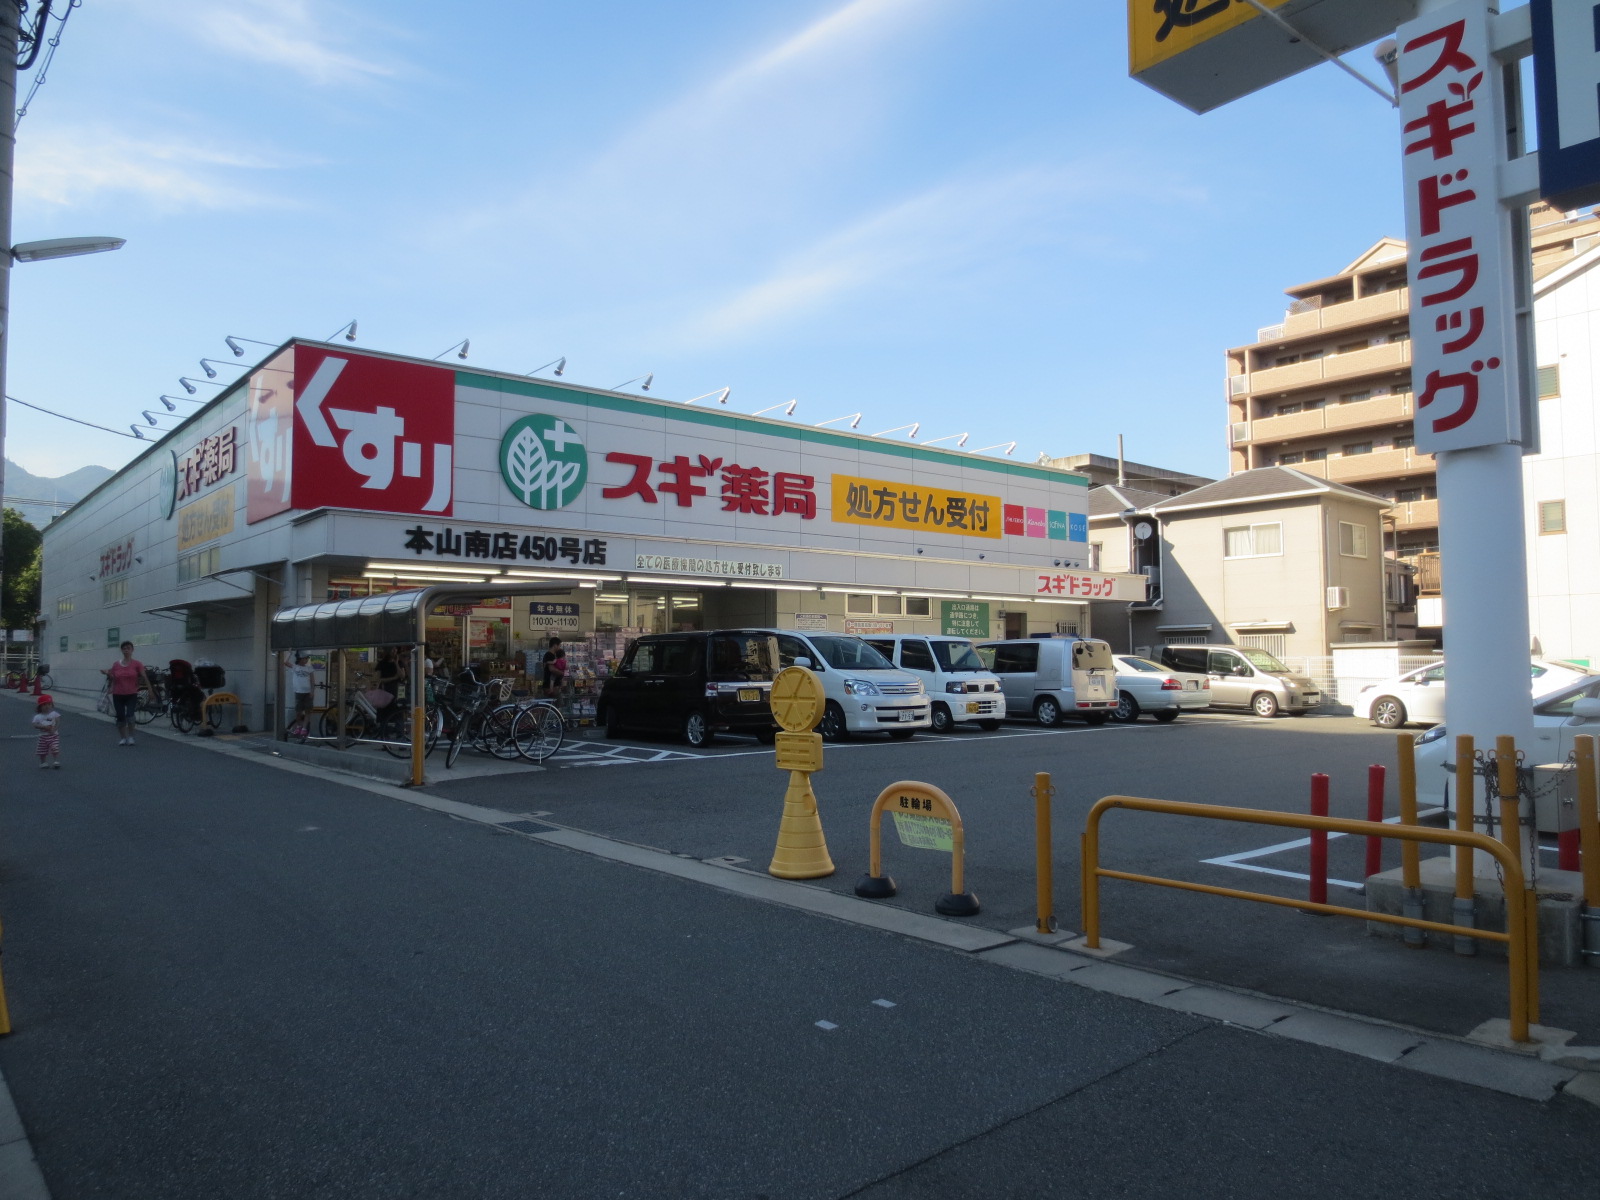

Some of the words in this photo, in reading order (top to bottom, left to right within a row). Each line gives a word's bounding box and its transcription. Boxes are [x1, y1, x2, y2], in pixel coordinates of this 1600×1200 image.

[1401, 19, 1500, 434] スギドラッグ
[296, 356, 452, 513] くすり
[177, 426, 238, 502] スギ薬局
[602, 451, 818, 520] スギ薬局
[846, 482, 990, 532] 処方せん受付
[404, 525, 607, 565] 本山南店450号店
[636, 554, 783, 577] 全ての医療機関の処方せん受付致します
[1037, 574, 1116, 597] スギドラッグ
[537, 604, 573, 614] 年中無休
[900, 796, 932, 811] 駐輪場
